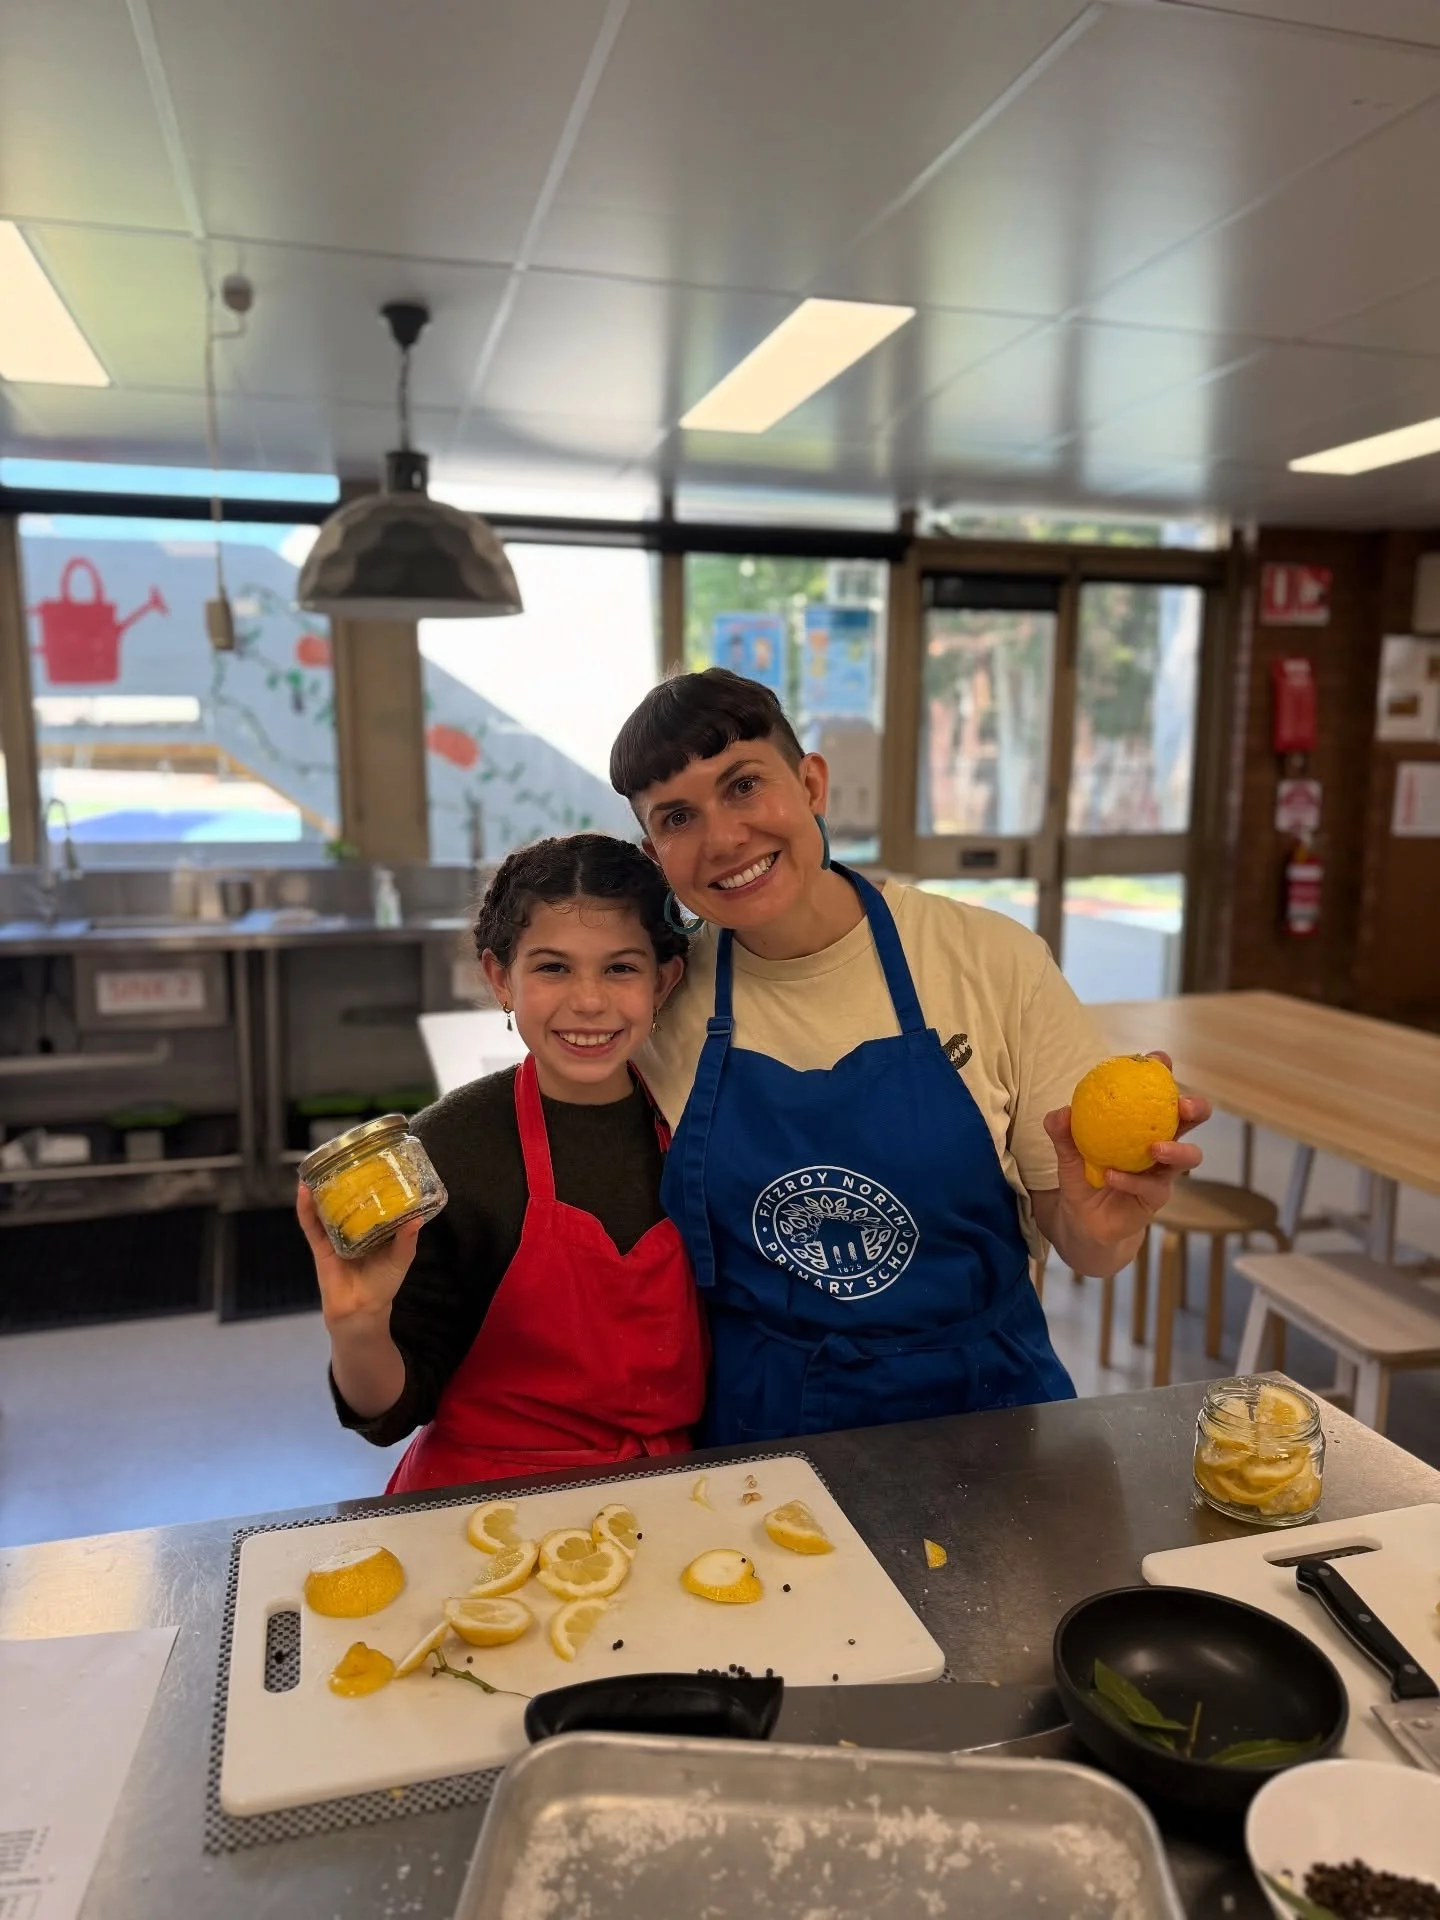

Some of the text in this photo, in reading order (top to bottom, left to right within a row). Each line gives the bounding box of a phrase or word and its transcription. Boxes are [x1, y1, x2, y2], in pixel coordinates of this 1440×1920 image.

[759, 1171, 908, 1227] FITZROY NORTH
[765, 1229, 914, 1294] PRIMARY SCHOO
